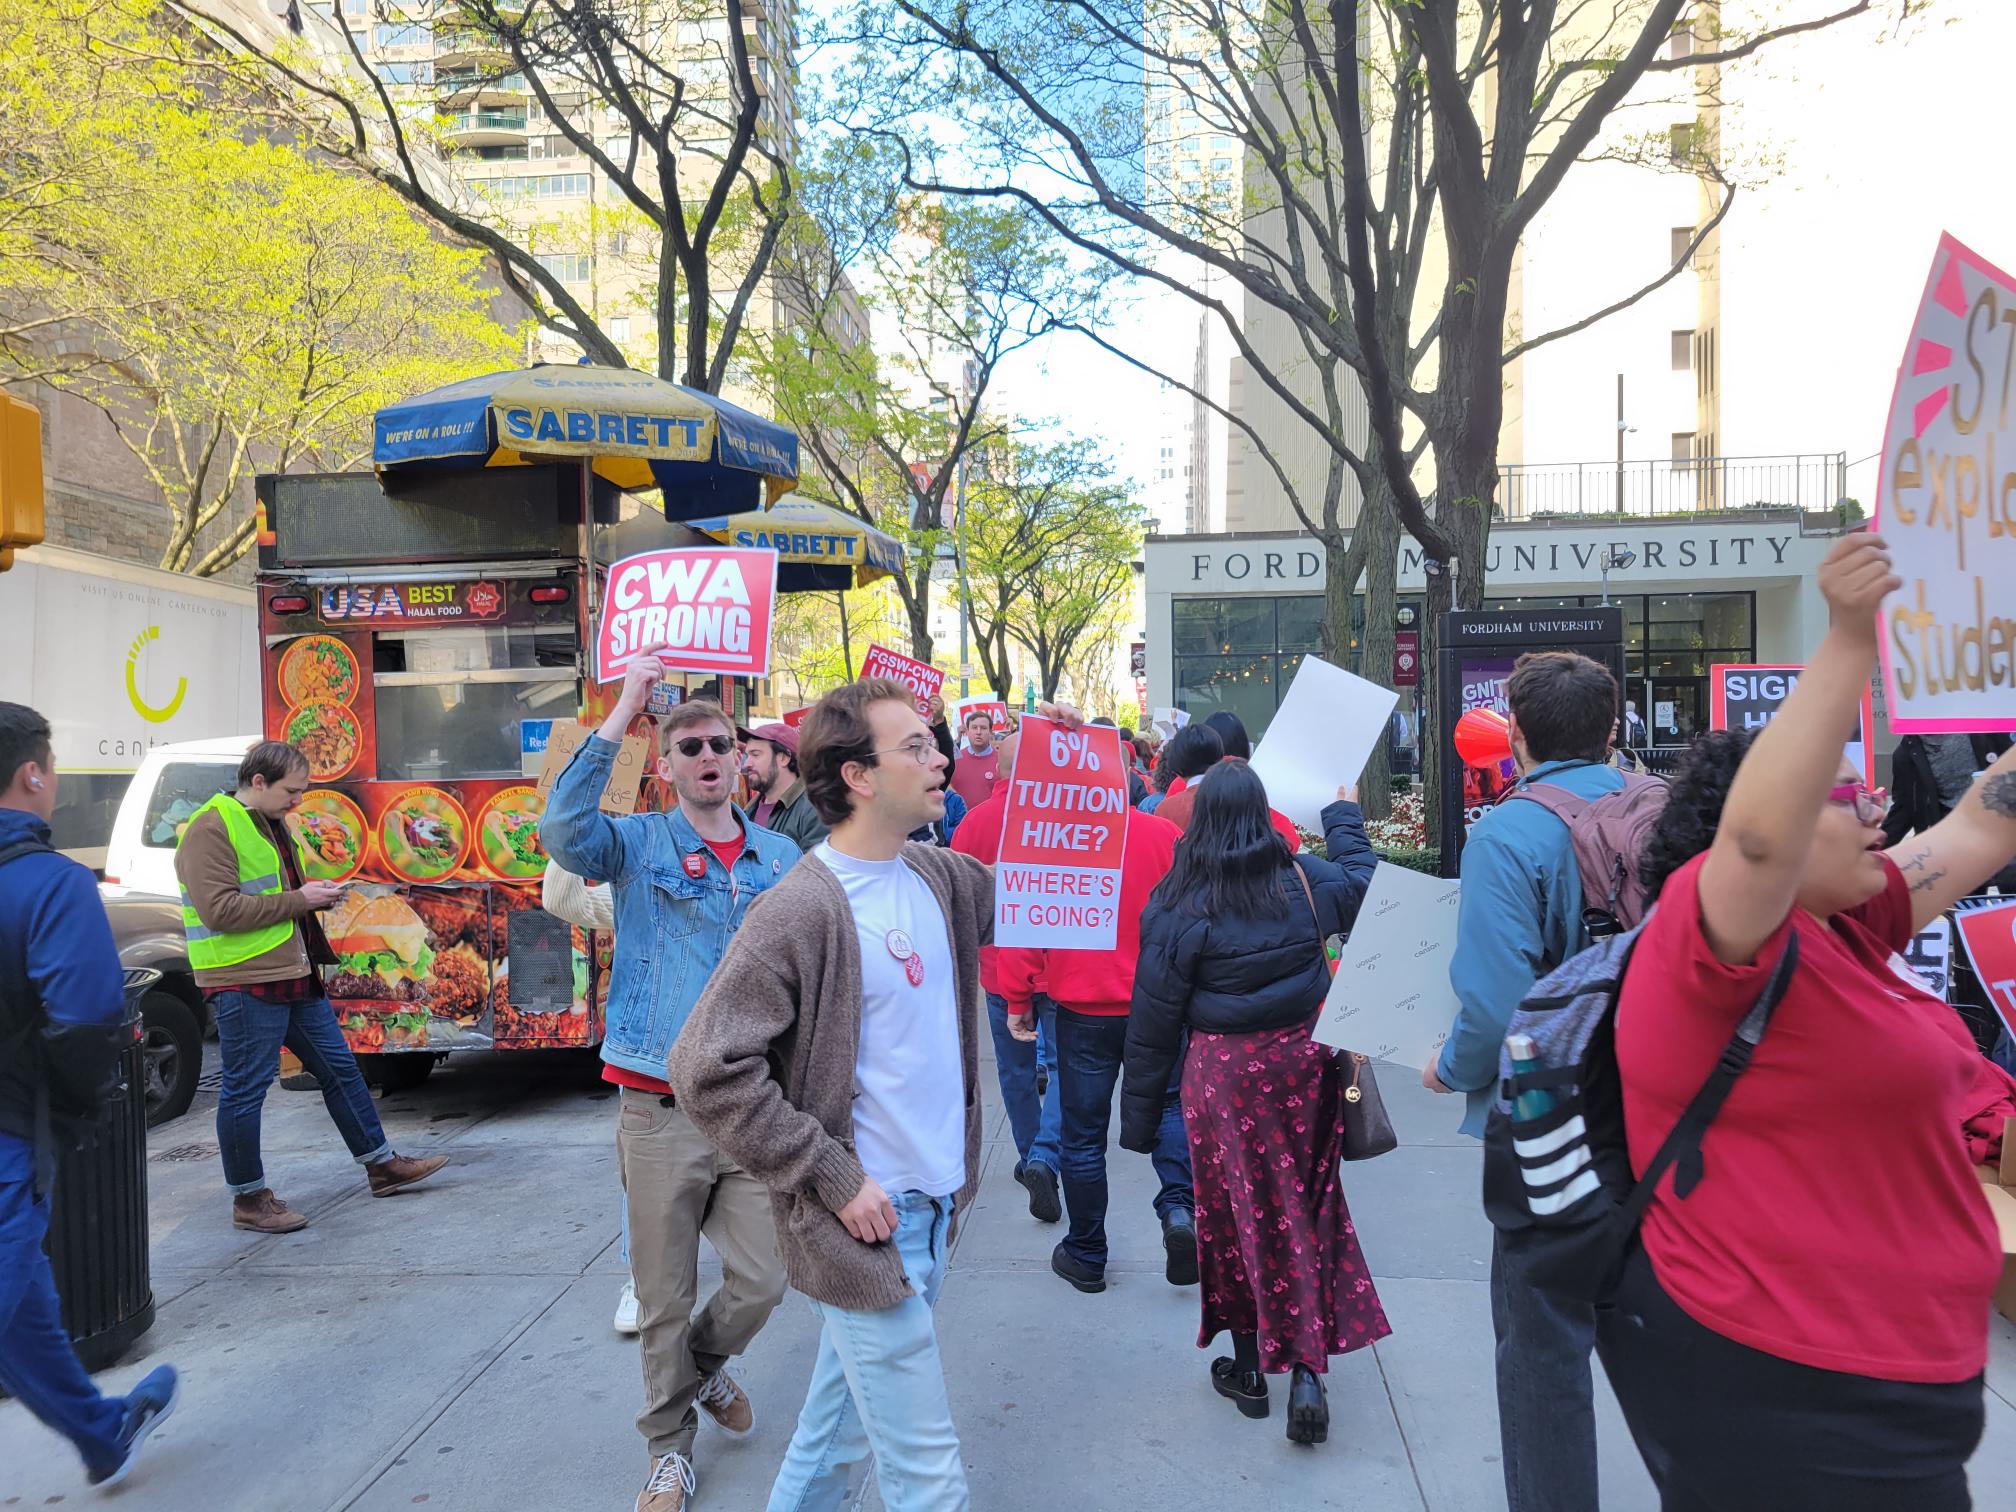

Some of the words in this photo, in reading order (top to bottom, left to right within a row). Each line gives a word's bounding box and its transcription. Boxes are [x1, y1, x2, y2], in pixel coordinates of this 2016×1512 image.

[385, 429, 414, 445] WE'RE
[415, 426, 431, 441] ON
[432, 426, 439, 439] A
[441, 423, 462, 439] ROLL
[504, 405, 705, 448] SABRETT
[736, 531, 858, 556] SABRETT
[1191, 550, 1428, 581] FORDM
[1484, 536, 1793, 573] UNIVERSITY
[81, 584, 107, 597] VISIT
[111, 591, 125, 601] US
[128, 592, 162, 607] ONLINE
[614, 558, 752, 611] CWA
[321, 587, 404, 619] USA
[408, 586, 456, 604] BEST
[407, 607, 436, 617] HALAL
[438, 606, 463, 616] FOOD
[610, 604, 751, 657] STRONG
[1462, 622, 1523, 635] FORDHAM
[1529, 619, 1605, 633] UNIVERSITY
[869, 648, 941, 686] FGSW-CWA
[661, 683, 680, 695] ACCEPT
[98, 735, 169, 757] cant
[1050, 729, 1101, 772] 6%
[1015, 779, 1124, 814] TUITION
[1021, 820, 1110, 852] HIKE?
[1003, 870, 1115, 897] WHERE'S
[1001, 903, 1021, 925] IT
[1028, 904, 1114, 928] GOING?
[1374, 900, 1401, 918] canson
[1355, 952, 1382, 970] canson
[1414, 941, 1441, 958] canson
[1394, 993, 1421, 1010] canson
[1334, 1006, 1361, 1024] canson
[1377, 1045, 1399, 1060] anson
